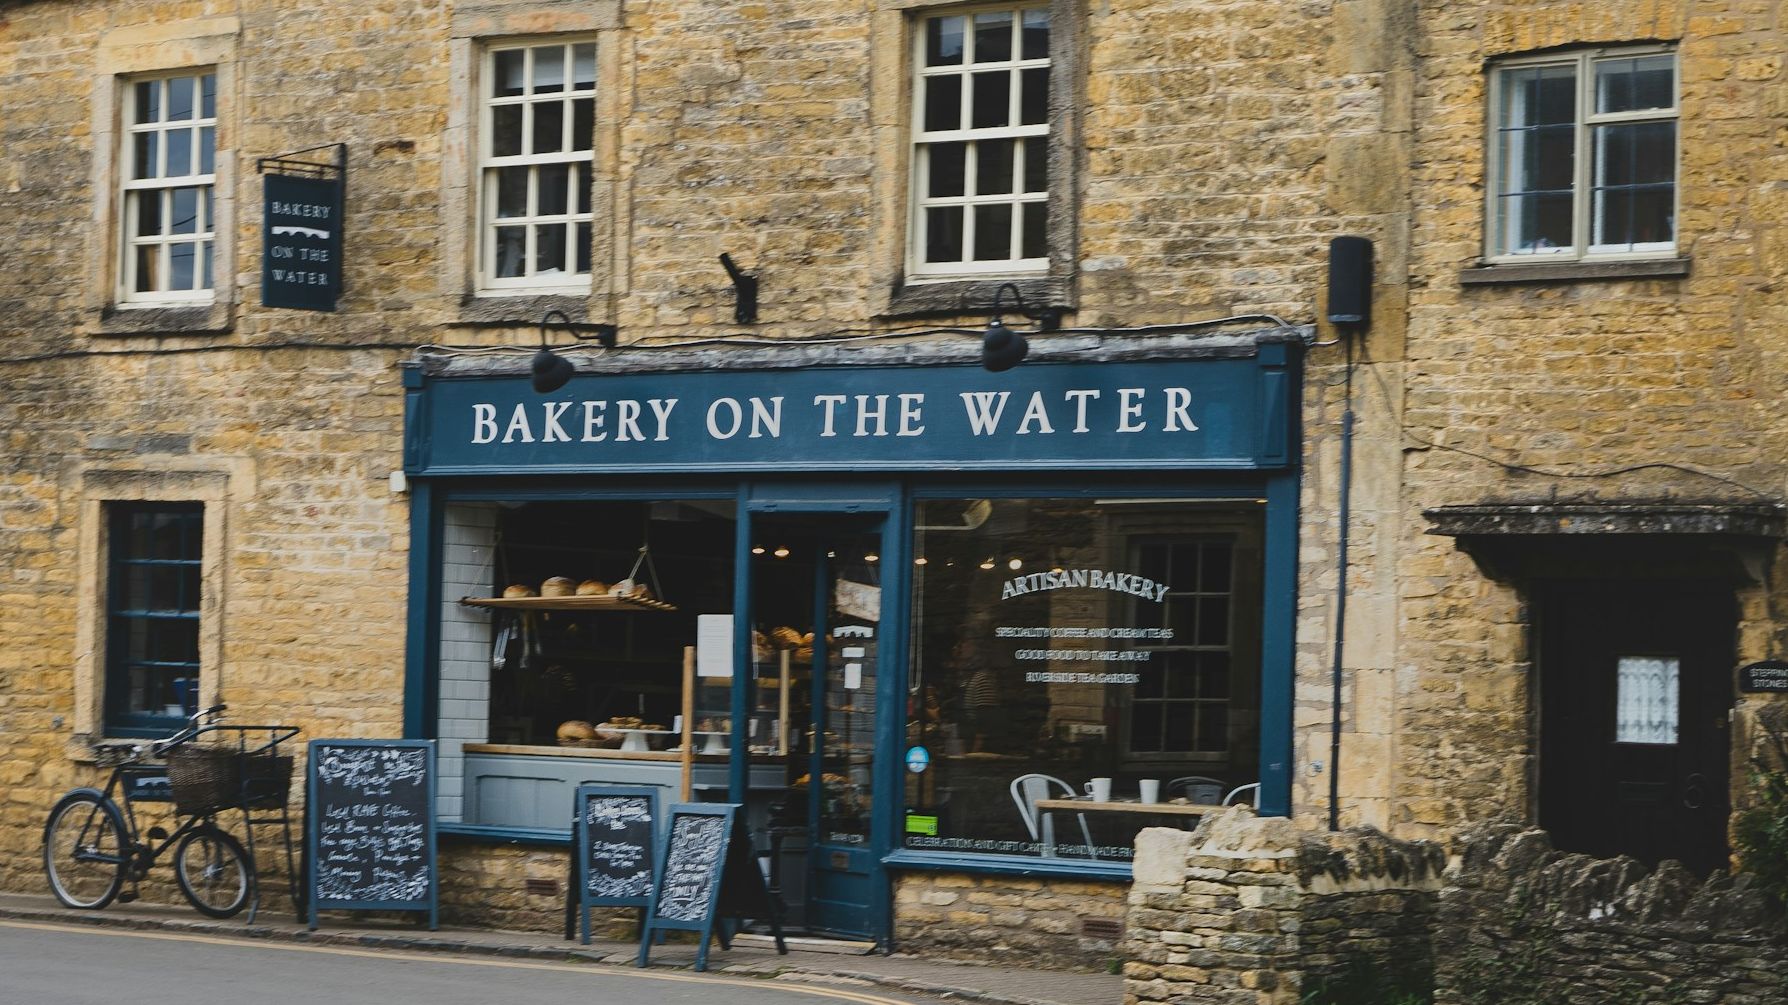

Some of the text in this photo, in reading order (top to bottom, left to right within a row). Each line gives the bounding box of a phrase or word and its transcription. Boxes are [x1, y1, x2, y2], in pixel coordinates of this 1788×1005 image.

[271, 201, 332, 219] BAKERY
[271, 246, 329, 262] ON THE
[271, 269, 329, 285] WATER
[471, 387, 1199, 444] BAKERY ON THE WATER
[1001, 569, 1171, 602] ARTISAN BAKERY
[1050, 627, 1088, 638] COFFEE
[1087, 627, 1110, 638] AND
[1109, 628, 1148, 639] CREAM
[1147, 628, 1174, 639] TEAS
[1014, 649, 1151, 661] GOOD FOOD TO TAKE AWAY
[1025, 672, 1077, 683] RIVERSIDE
[1076, 673, 1097, 683] TEA
